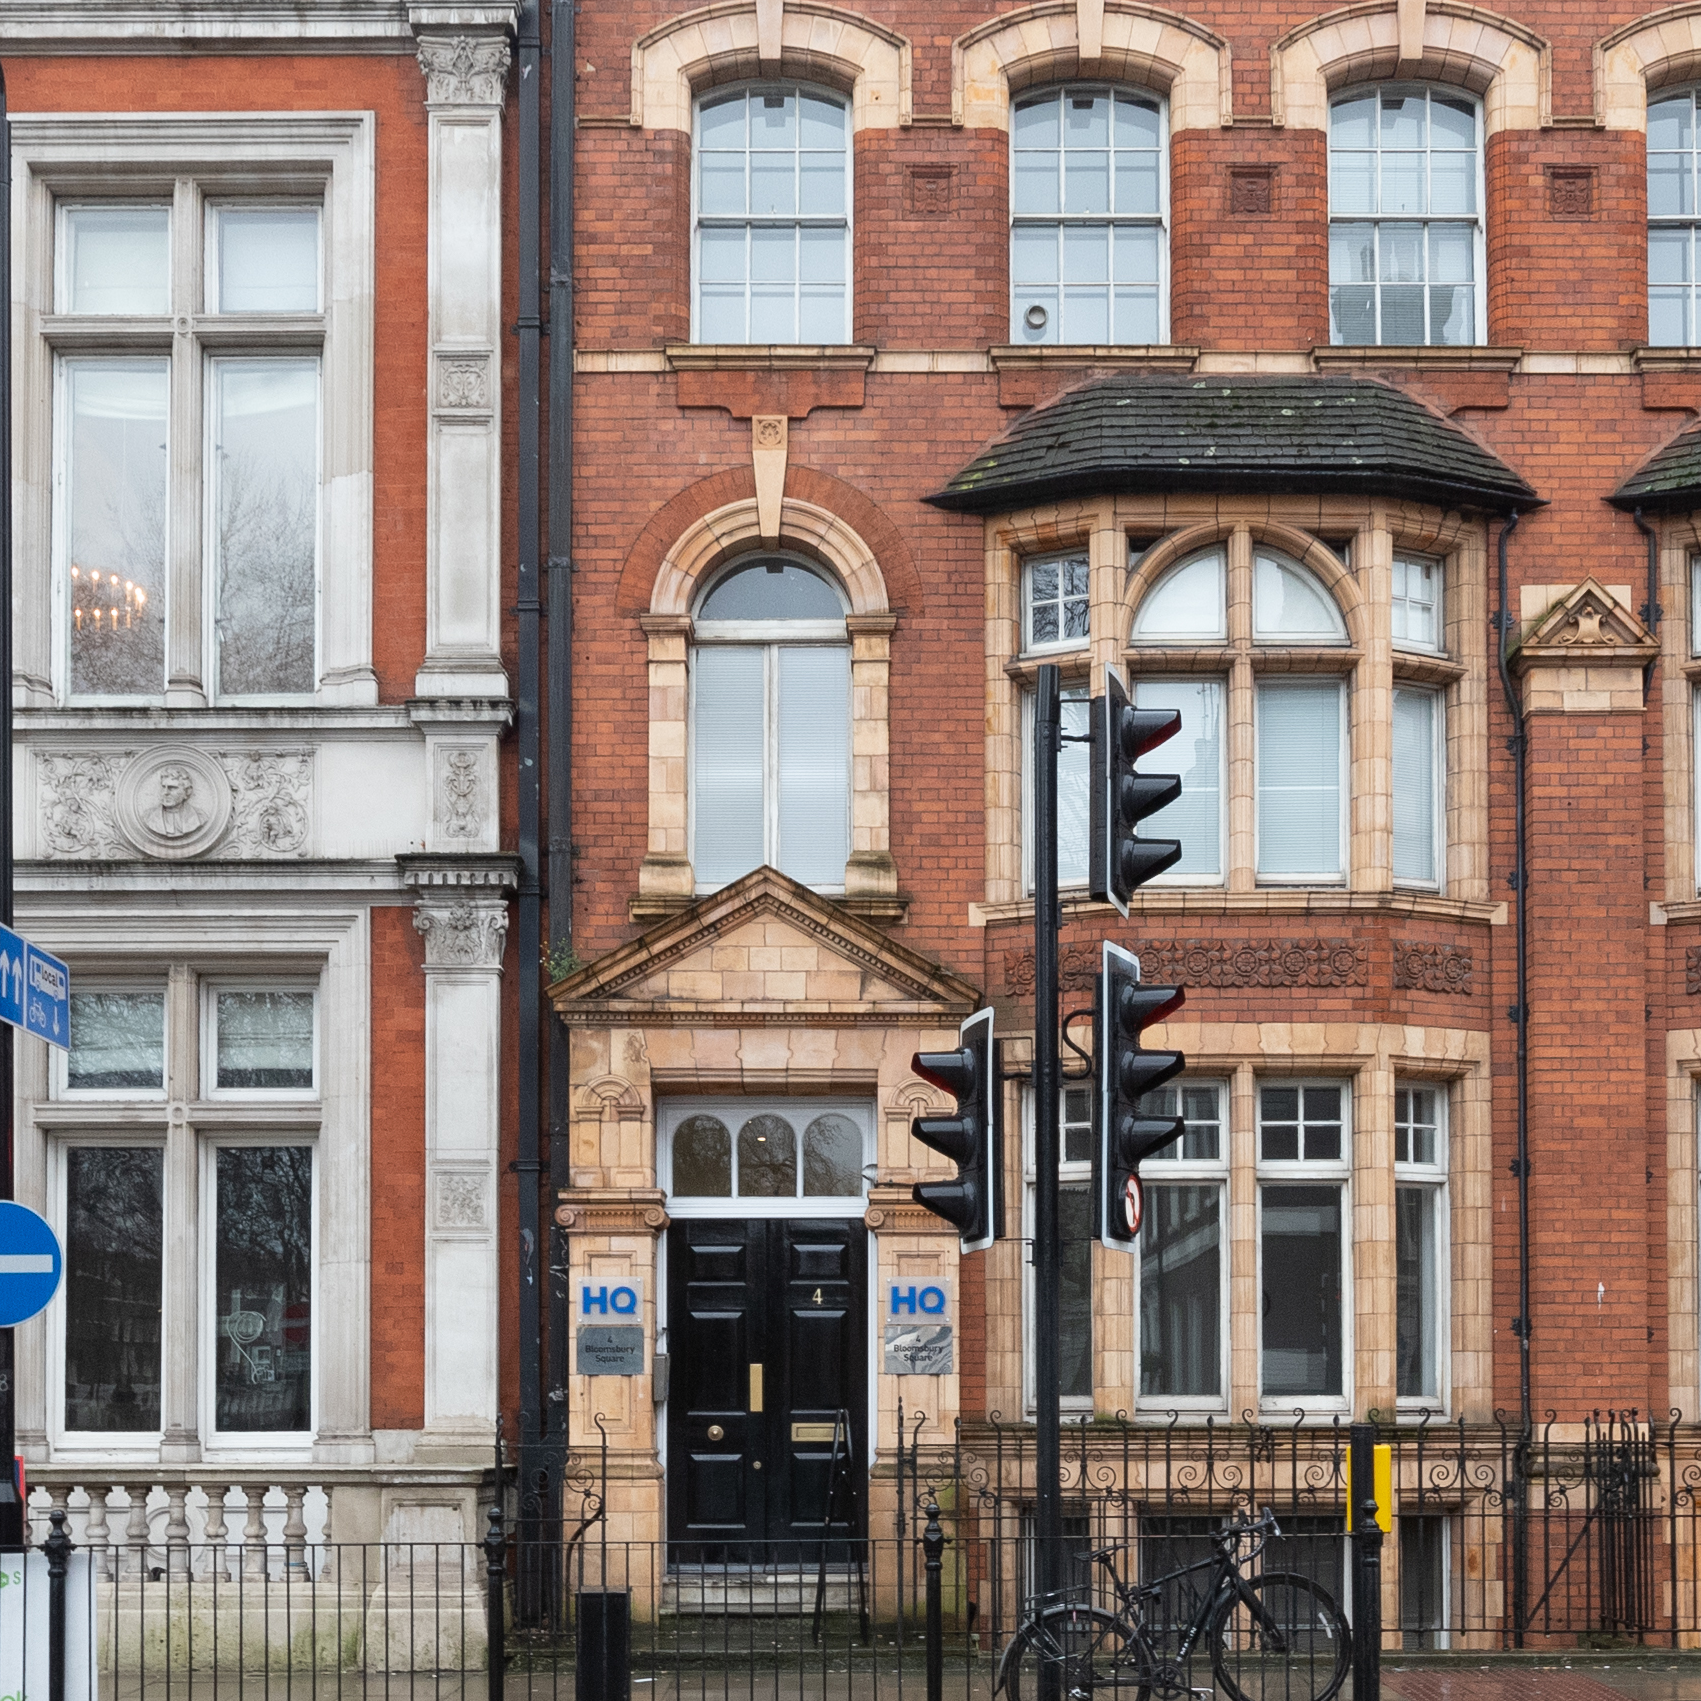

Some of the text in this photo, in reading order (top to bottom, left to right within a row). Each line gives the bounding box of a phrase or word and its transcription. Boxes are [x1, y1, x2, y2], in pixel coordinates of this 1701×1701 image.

[41, 964, 59, 988] local
[582, 1285, 638, 1315] HQ
[811, 1287, 824, 1305] 4
[890, 1285, 946, 1315] HQ
[607, 1335, 614, 1344] 4
[915, 1334, 922, 1343] 4
[584, 1344, 636, 1355] Bloomsbury
[893, 1344, 944, 1354] Bloomsbury
[595, 1354, 626, 1364] Square
[903, 1353, 934, 1363] Square
